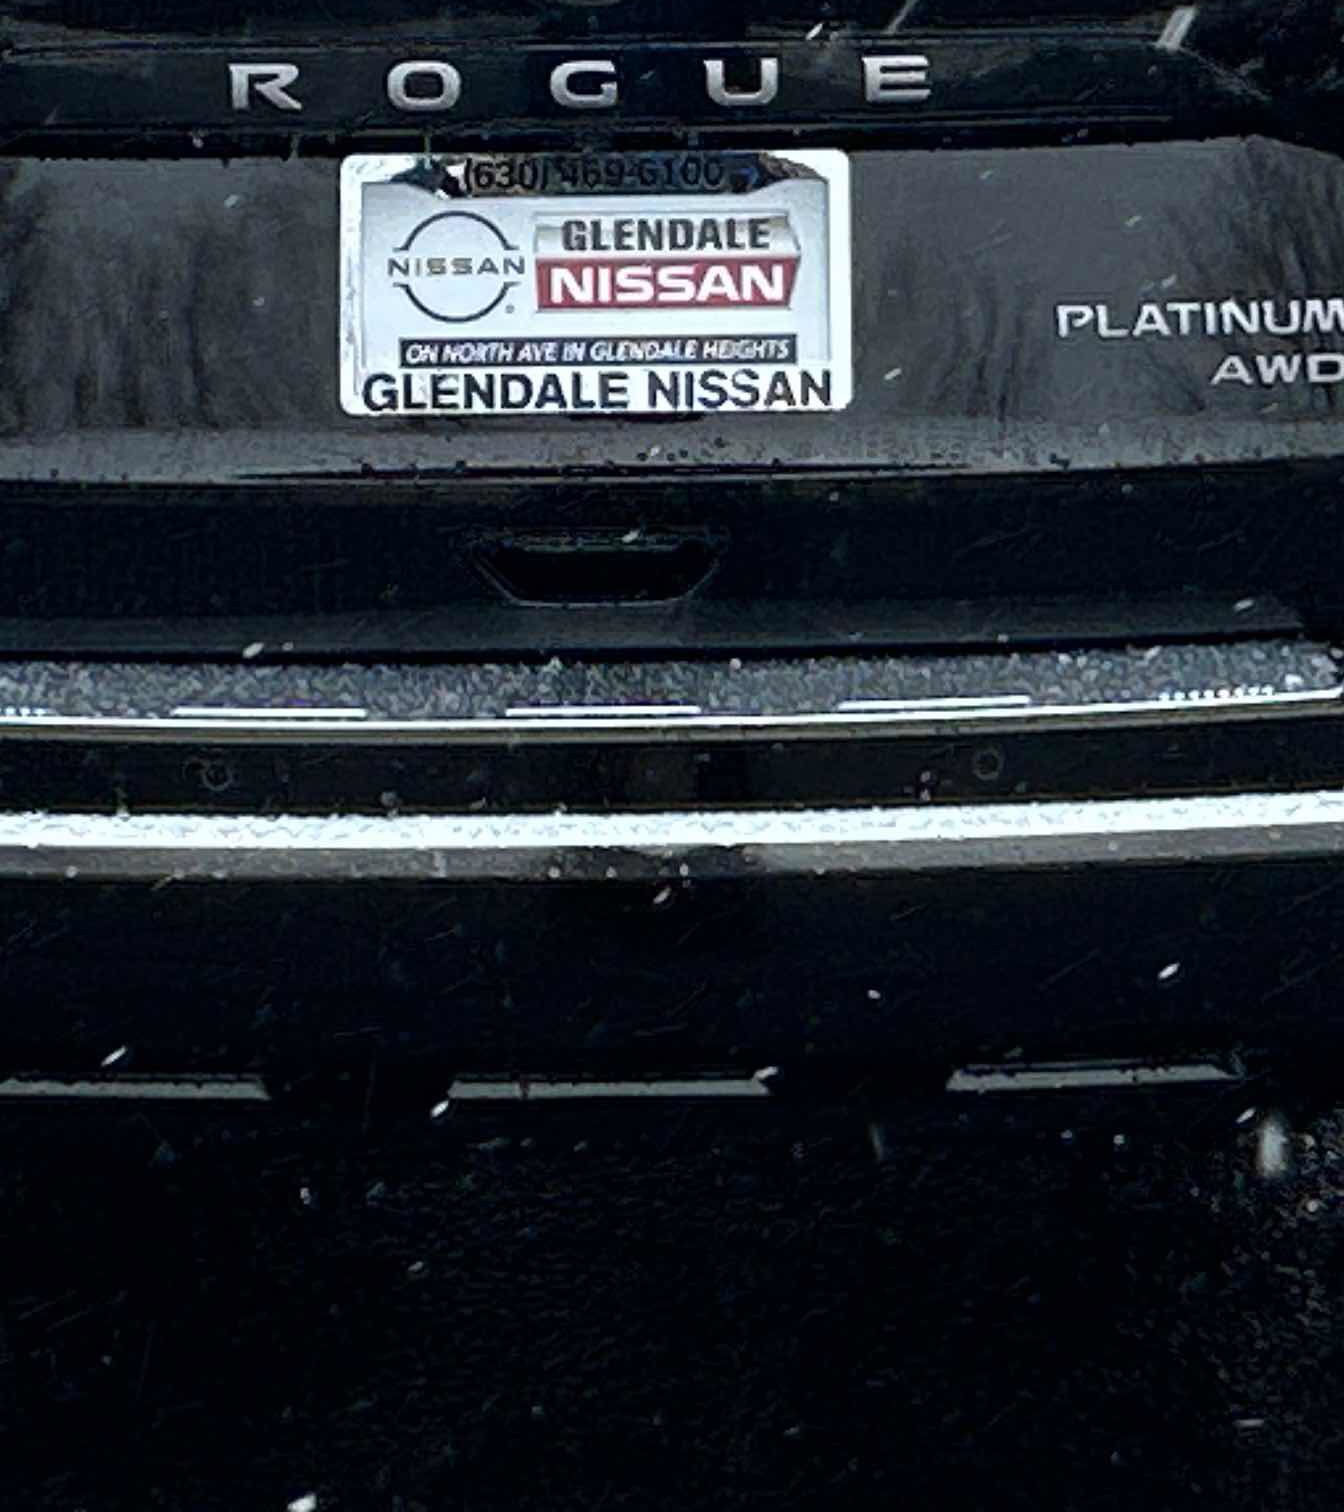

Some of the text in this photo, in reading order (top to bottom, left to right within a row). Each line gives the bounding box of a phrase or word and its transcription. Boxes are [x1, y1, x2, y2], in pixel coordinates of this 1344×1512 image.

[228, 53, 932, 112] ROGUE
[463, 157, 546, 195] (630)
[561, 217, 771, 252] GLENDALE
[388, 255, 526, 276] NISSAN
[549, 263, 785, 304] NISSAN
[405, 338, 791, 365] ON NORTH AVE IN GLENDALE HEIGHTS
[363, 367, 832, 412] GLENDALE NISSAN
